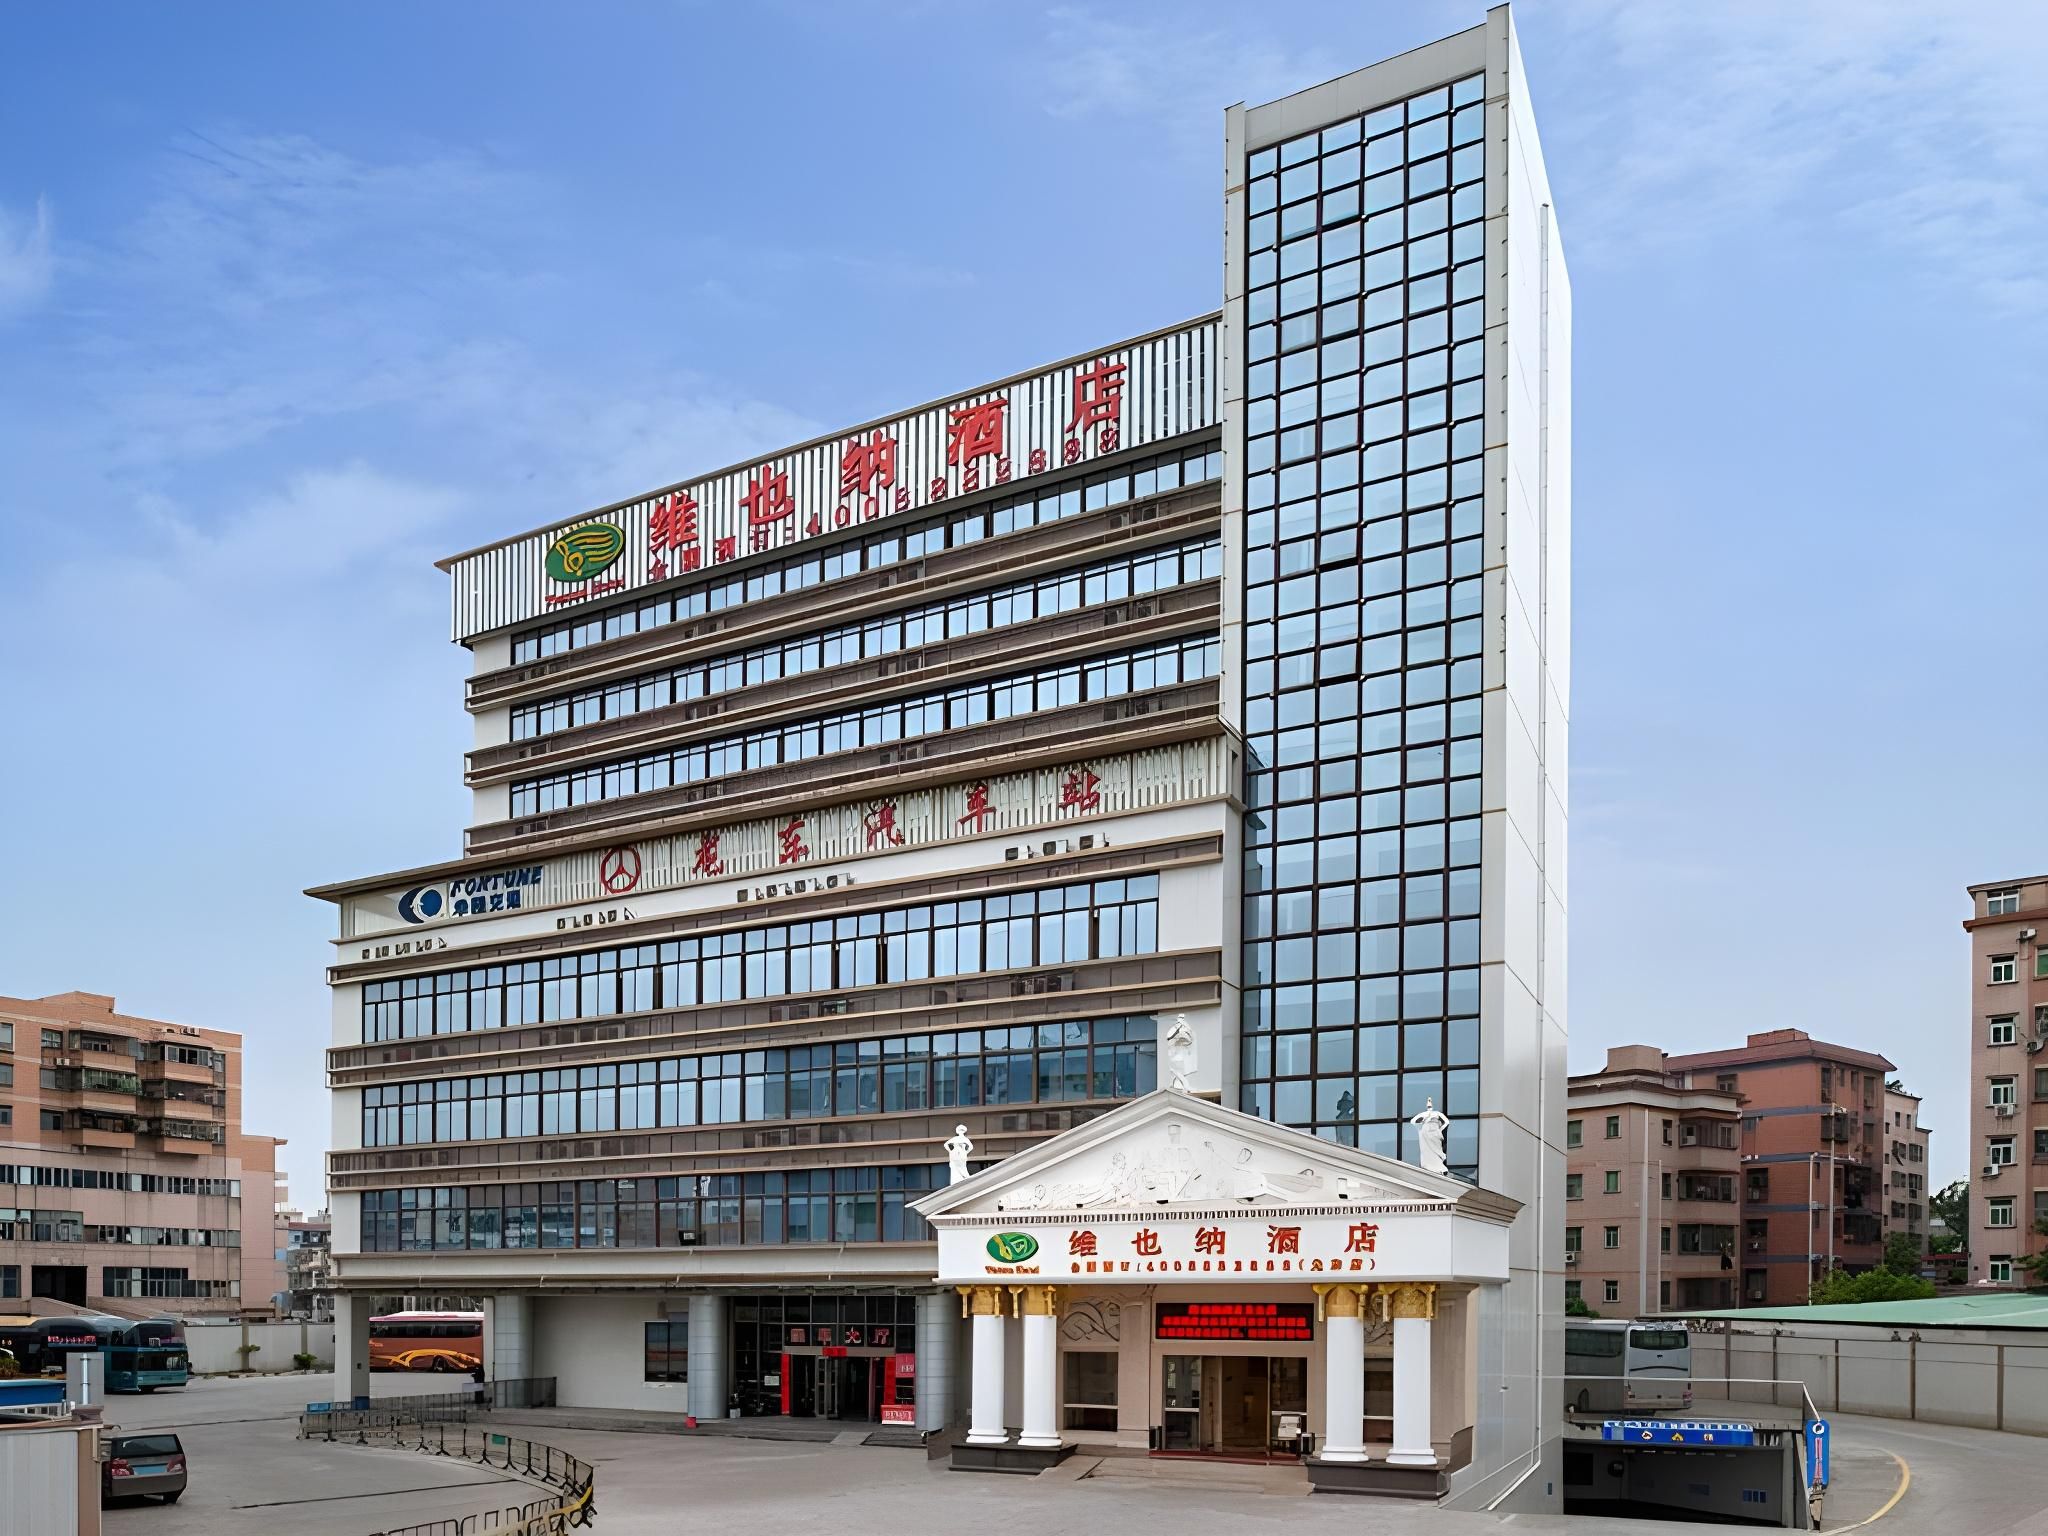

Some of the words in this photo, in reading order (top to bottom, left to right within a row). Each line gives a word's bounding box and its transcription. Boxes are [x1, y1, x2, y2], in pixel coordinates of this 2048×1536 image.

[650, 358, 1128, 550] 维也纳酒店
[1068, 1222, 1380, 1257] 维也纳酒店
